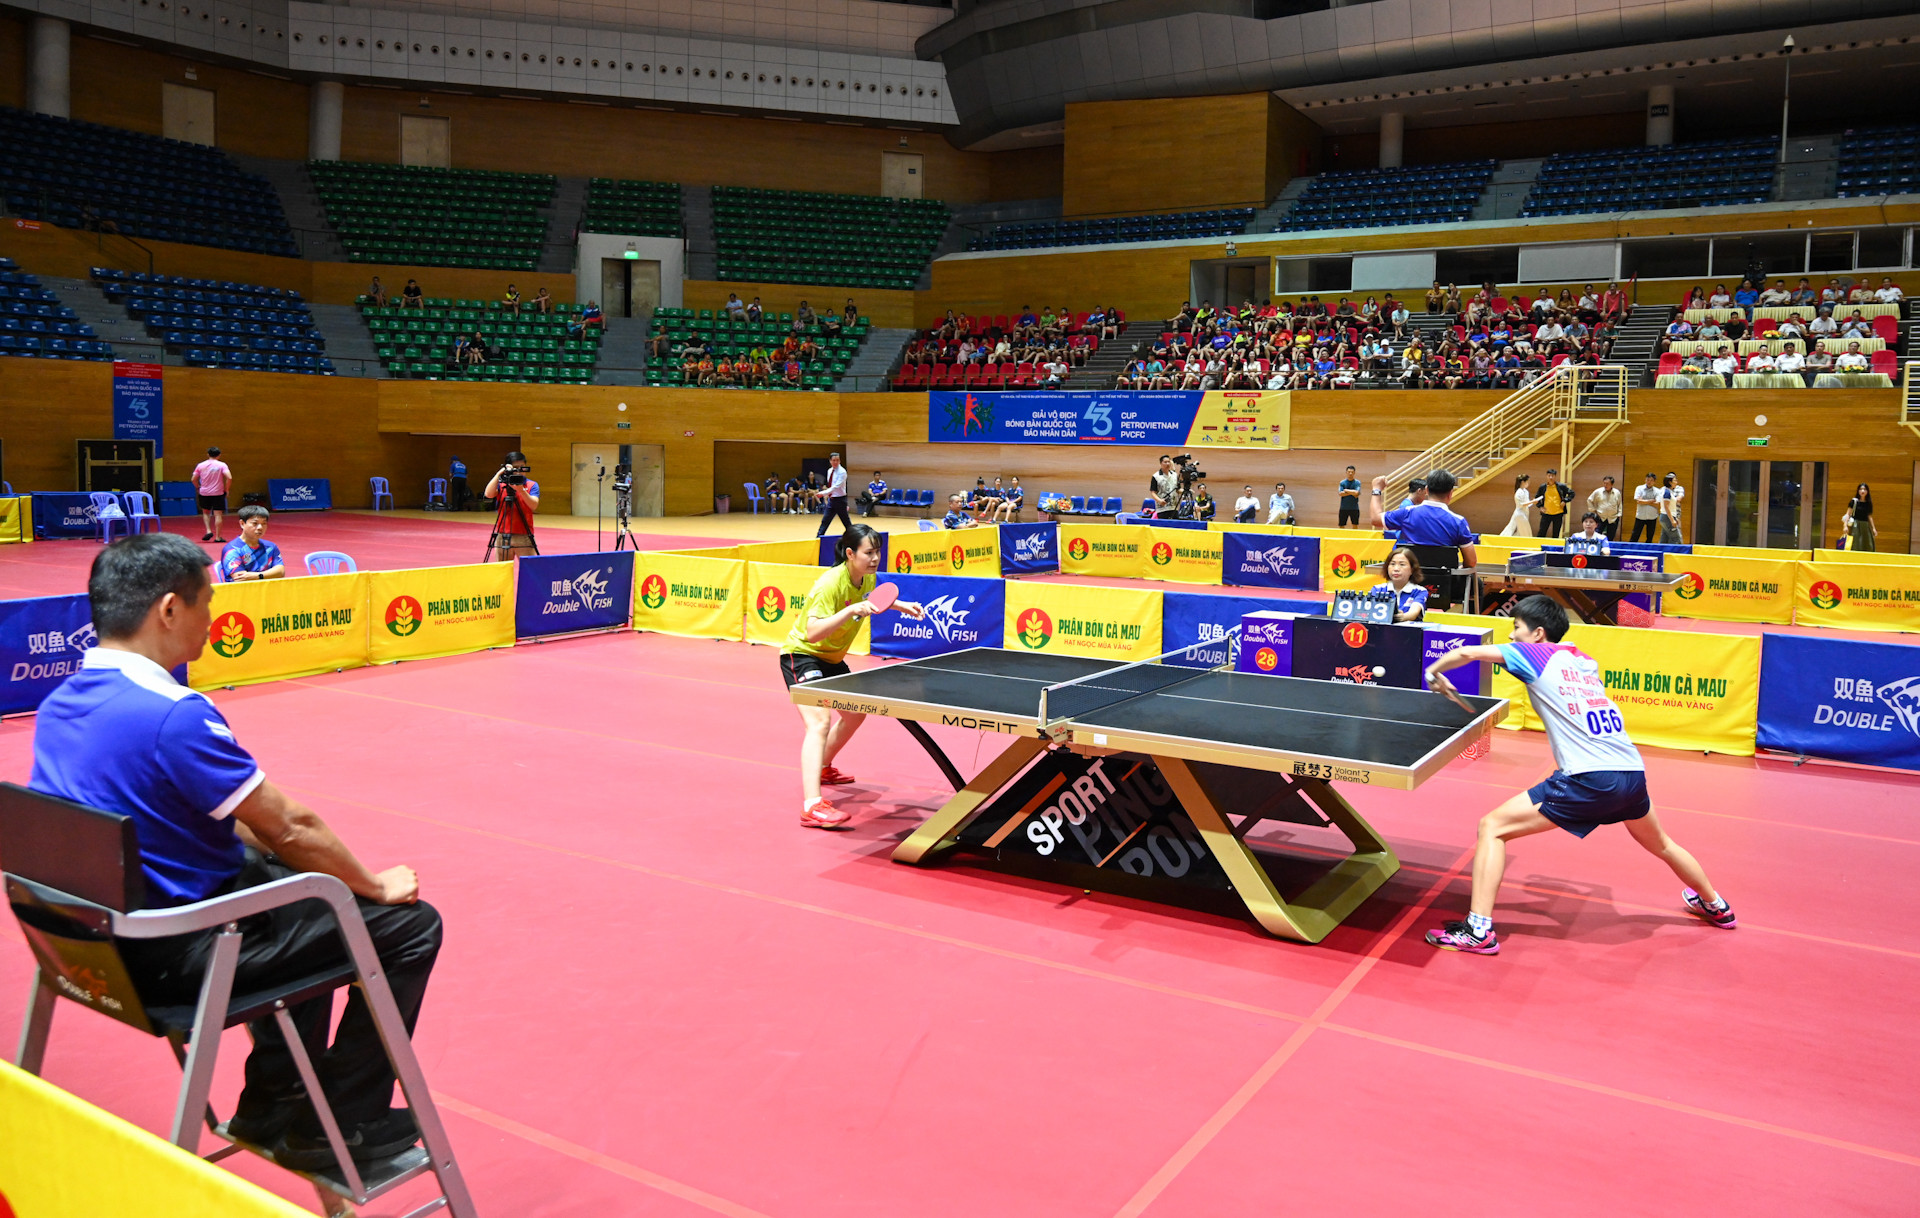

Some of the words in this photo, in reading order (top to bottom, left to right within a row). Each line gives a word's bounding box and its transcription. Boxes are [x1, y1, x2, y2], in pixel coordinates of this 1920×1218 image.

[1005, 417, 1025, 428] BÓNG
[1026, 418, 1041, 428] BÀN
[1042, 417, 1063, 428] QUỐC
[1064, 420, 1077, 428] GIA
[1032, 409, 1046, 418] GIẢI
[1048, 411, 1058, 419] VÔ
[1059, 412, 1077, 421] ĐỊCH
[1083, 401, 1113, 436] 43
[1024, 428, 1039, 437] BÁO
[1040, 428, 1060, 437] NHÂN
[1061, 429, 1077, 437] DÂN
[1121, 421, 1179, 429] PETROVIETNAM
[596, 456, 600, 464] 2
[63, 517, 89, 525] DOUBLE
[1092, 541, 1106, 551] PHÂN
[1127, 544, 1138, 552] MAU
[1175, 547, 1189, 557] PHÂN
[1211, 550, 1223, 560] MAU
[1014, 552, 1033, 561] Double
[1576, 558, 1582, 566] 7
[1240, 563, 1270, 573] Double
[1281, 567, 1300, 575] FISH
[671, 582, 688, 598] PHÂN
[689, 584, 702, 599] BÓN
[704, 585, 712, 600] CÀ
[1709, 577, 1730, 590] PHÂN
[1732, 579, 1747, 592] BÓN
[1749, 580, 1759, 592] CÀ
[1761, 583, 1778, 594] MAU
[1848, 586, 1870, 599] PHÂN
[1872, 588, 1888, 600] BÓN
[1891, 588, 1902, 600] CÀ
[428, 598, 451, 616] PHÂN
[453, 596, 470, 613] BÓN
[472, 594, 483, 611] CÀ
[485, 594, 501, 610] MAU
[542, 600, 580, 614] Double
[593, 597, 613, 609] FISH
[1338, 600, 1353, 617] 9
[1372, 603, 1388, 620] 3
[262, 613, 289, 634] PHÂN
[292, 611, 312, 630] BÓN
[315, 608, 328, 627] CÀ
[331, 608, 352, 626] MAU
[1058, 617, 1083, 635] PHÂN
[1085, 619, 1103, 637] BÓN
[1106, 620, 1118, 638] CÀ
[1120, 624, 1141, 640] MAU
[270, 636, 282, 646] HẠT
[284, 634, 306, 642] NGỌC
[308, 630, 323, 640] MÙA
[325, 629, 345, 638] VÀNG
[893, 623, 934, 639] Double
[951, 630, 978, 642] FISH
[1243, 634, 1266, 643] Double
[1348, 628, 1364, 643] 11
[28, 631, 66, 655] 双魚
[1077, 640, 1096, 648] NGỌC
[1258, 652, 1275, 667] 28
[10, 660, 84, 681] DOUBLE
[1604, 668, 1640, 691] PHÂN
[1644, 671, 1671, 693] BÓN
[1675, 673, 1693, 696] CÀ
[1697, 678, 1727, 698] MAU
[1834, 677, 1874, 703] 双魚
[832, 700, 858, 711] Double
[860, 704, 877, 713] FISH
[1613, 694, 1629, 705] HẠT
[1631, 696, 1660, 707] NGỌC
[1662, 698, 1683, 708] MÙA
[1686, 699, 1714, 711] VÀNG
[942, 714, 1018, 734] MOFIT
[1586, 709, 1622, 735] 056
[1813, 704, 1895, 731] DOUBLE
[1335, 767, 1360, 776] Volant
[1335, 773, 1360, 783] Dream
[1361, 770, 1370, 784] 3
[1026, 758, 1116, 856] SPORT
[1068, 762, 1173, 867] PING
[1118, 811, 1206, 878] PON
[100, 996, 123, 1010] FISH
